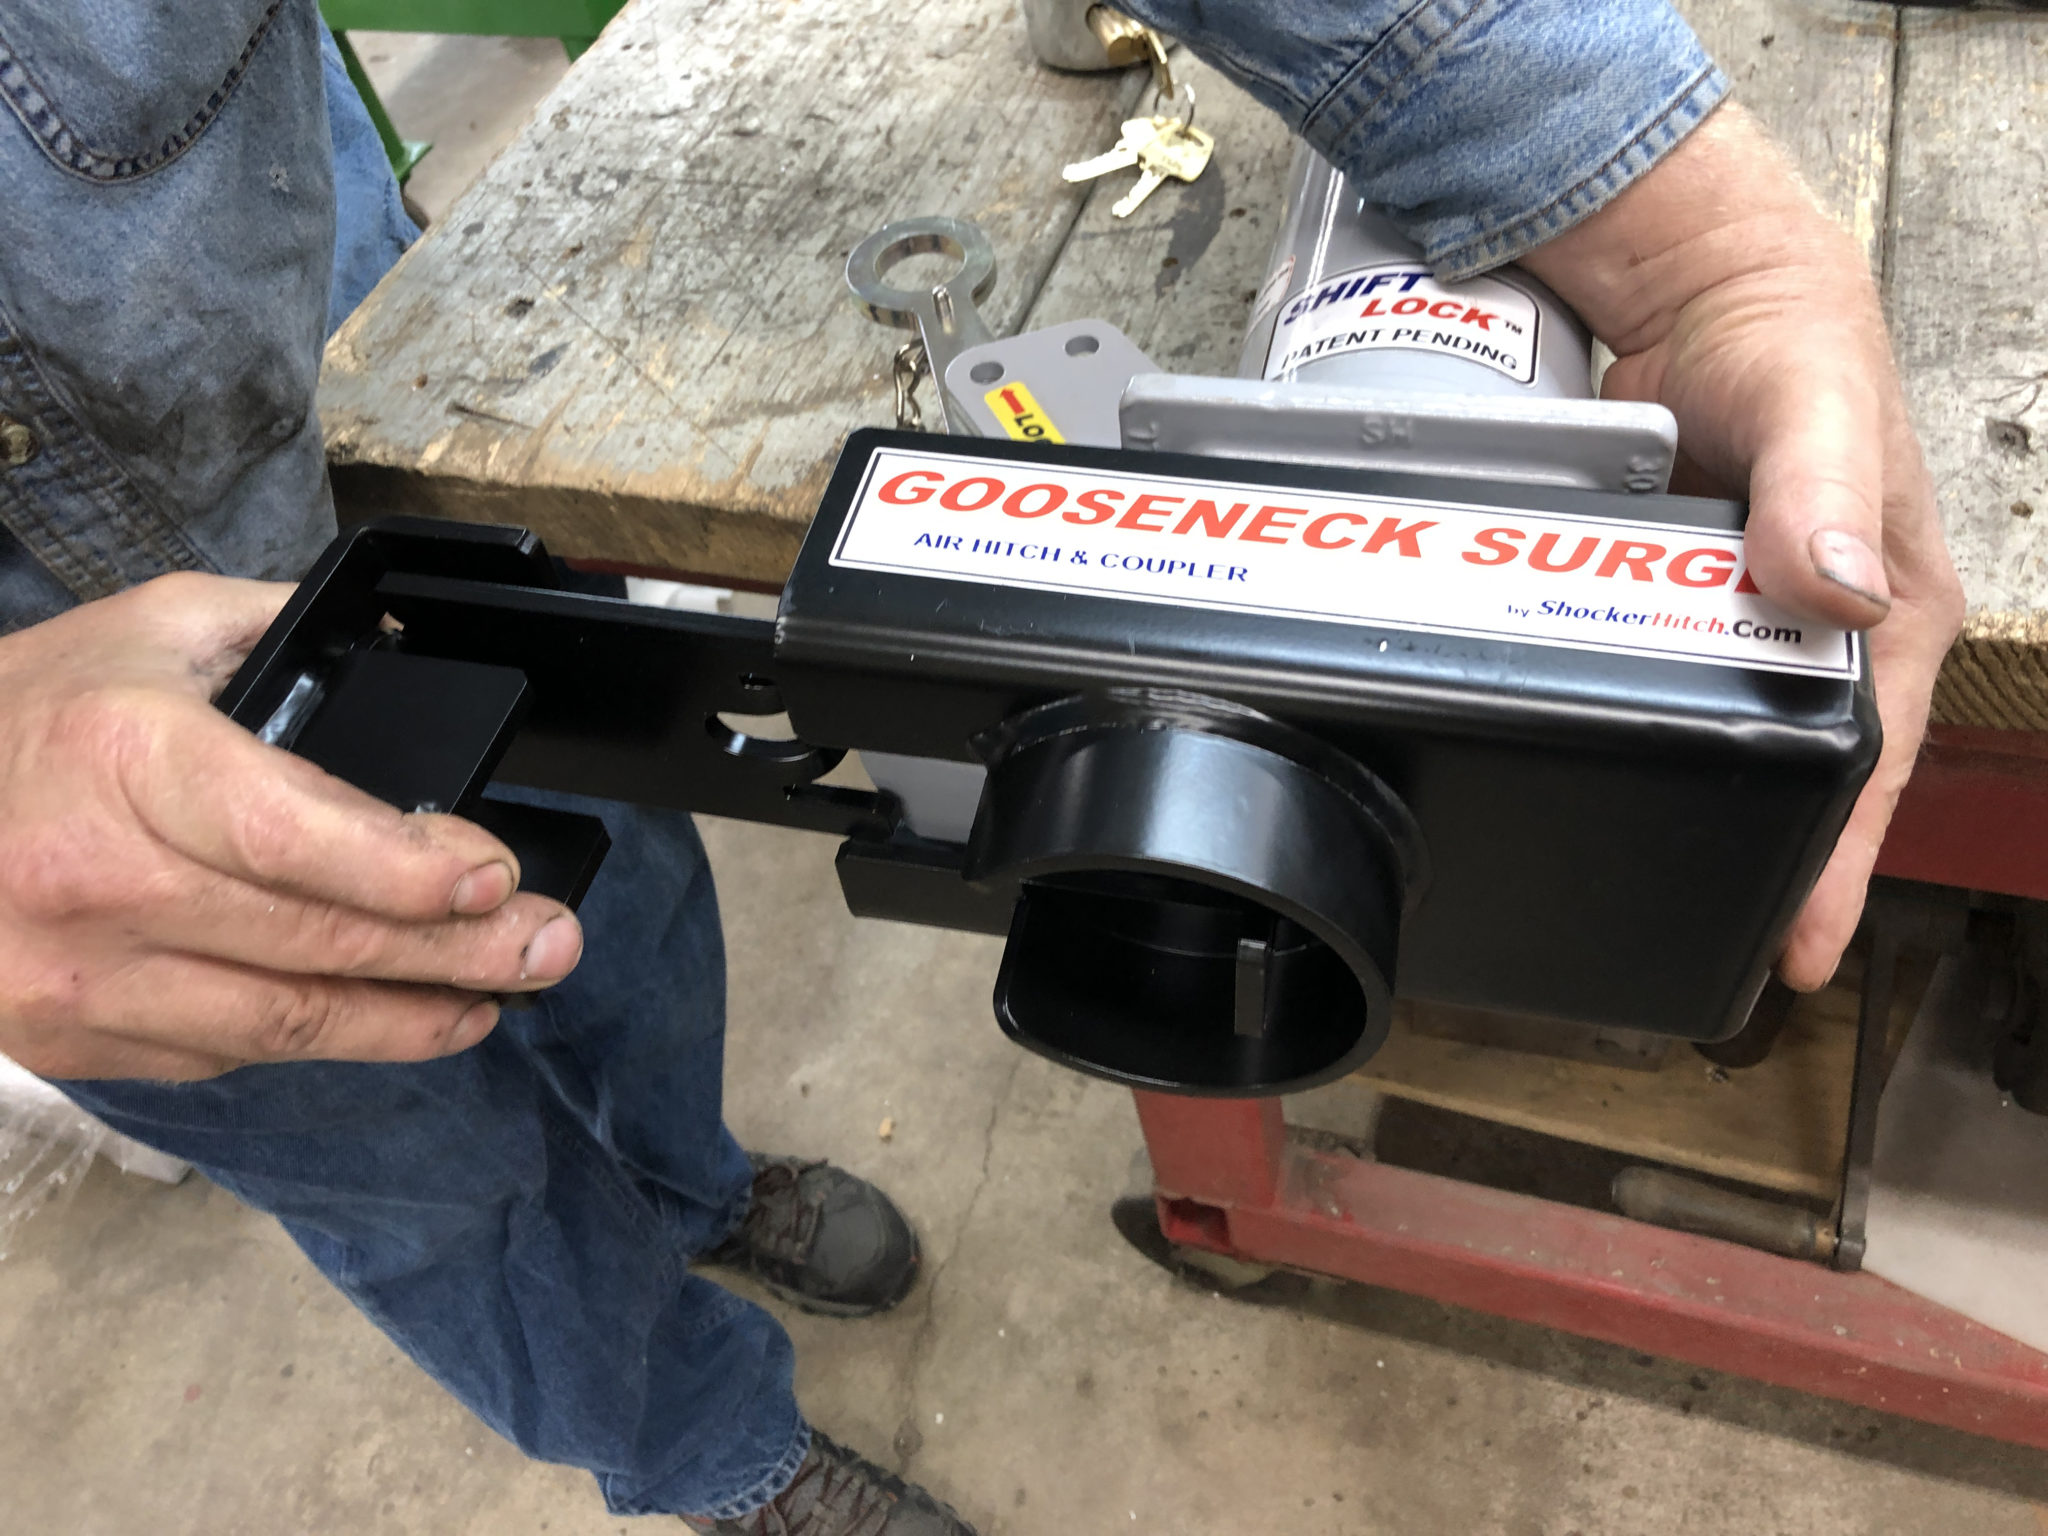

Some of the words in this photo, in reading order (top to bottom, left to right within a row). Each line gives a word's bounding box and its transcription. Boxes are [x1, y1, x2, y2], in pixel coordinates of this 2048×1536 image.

[1284, 272, 1434, 326] SHIFT
[1281, 328, 1386, 370] PATENT
[1392, 327, 1517, 370] PENDING
[1014, 413, 1052, 442] LO
[878, 470, 1440, 558] GOOSENECK
[1461, 527, 1762, 596] SURG
[913, 533, 963, 551] AIR
[972, 538, 1061, 562] HITCH
[1070, 550, 1088, 566] &
[1100, 553, 1248, 583] COUPLER
[1537, 600, 1803, 644] ShockerHitch.Com
